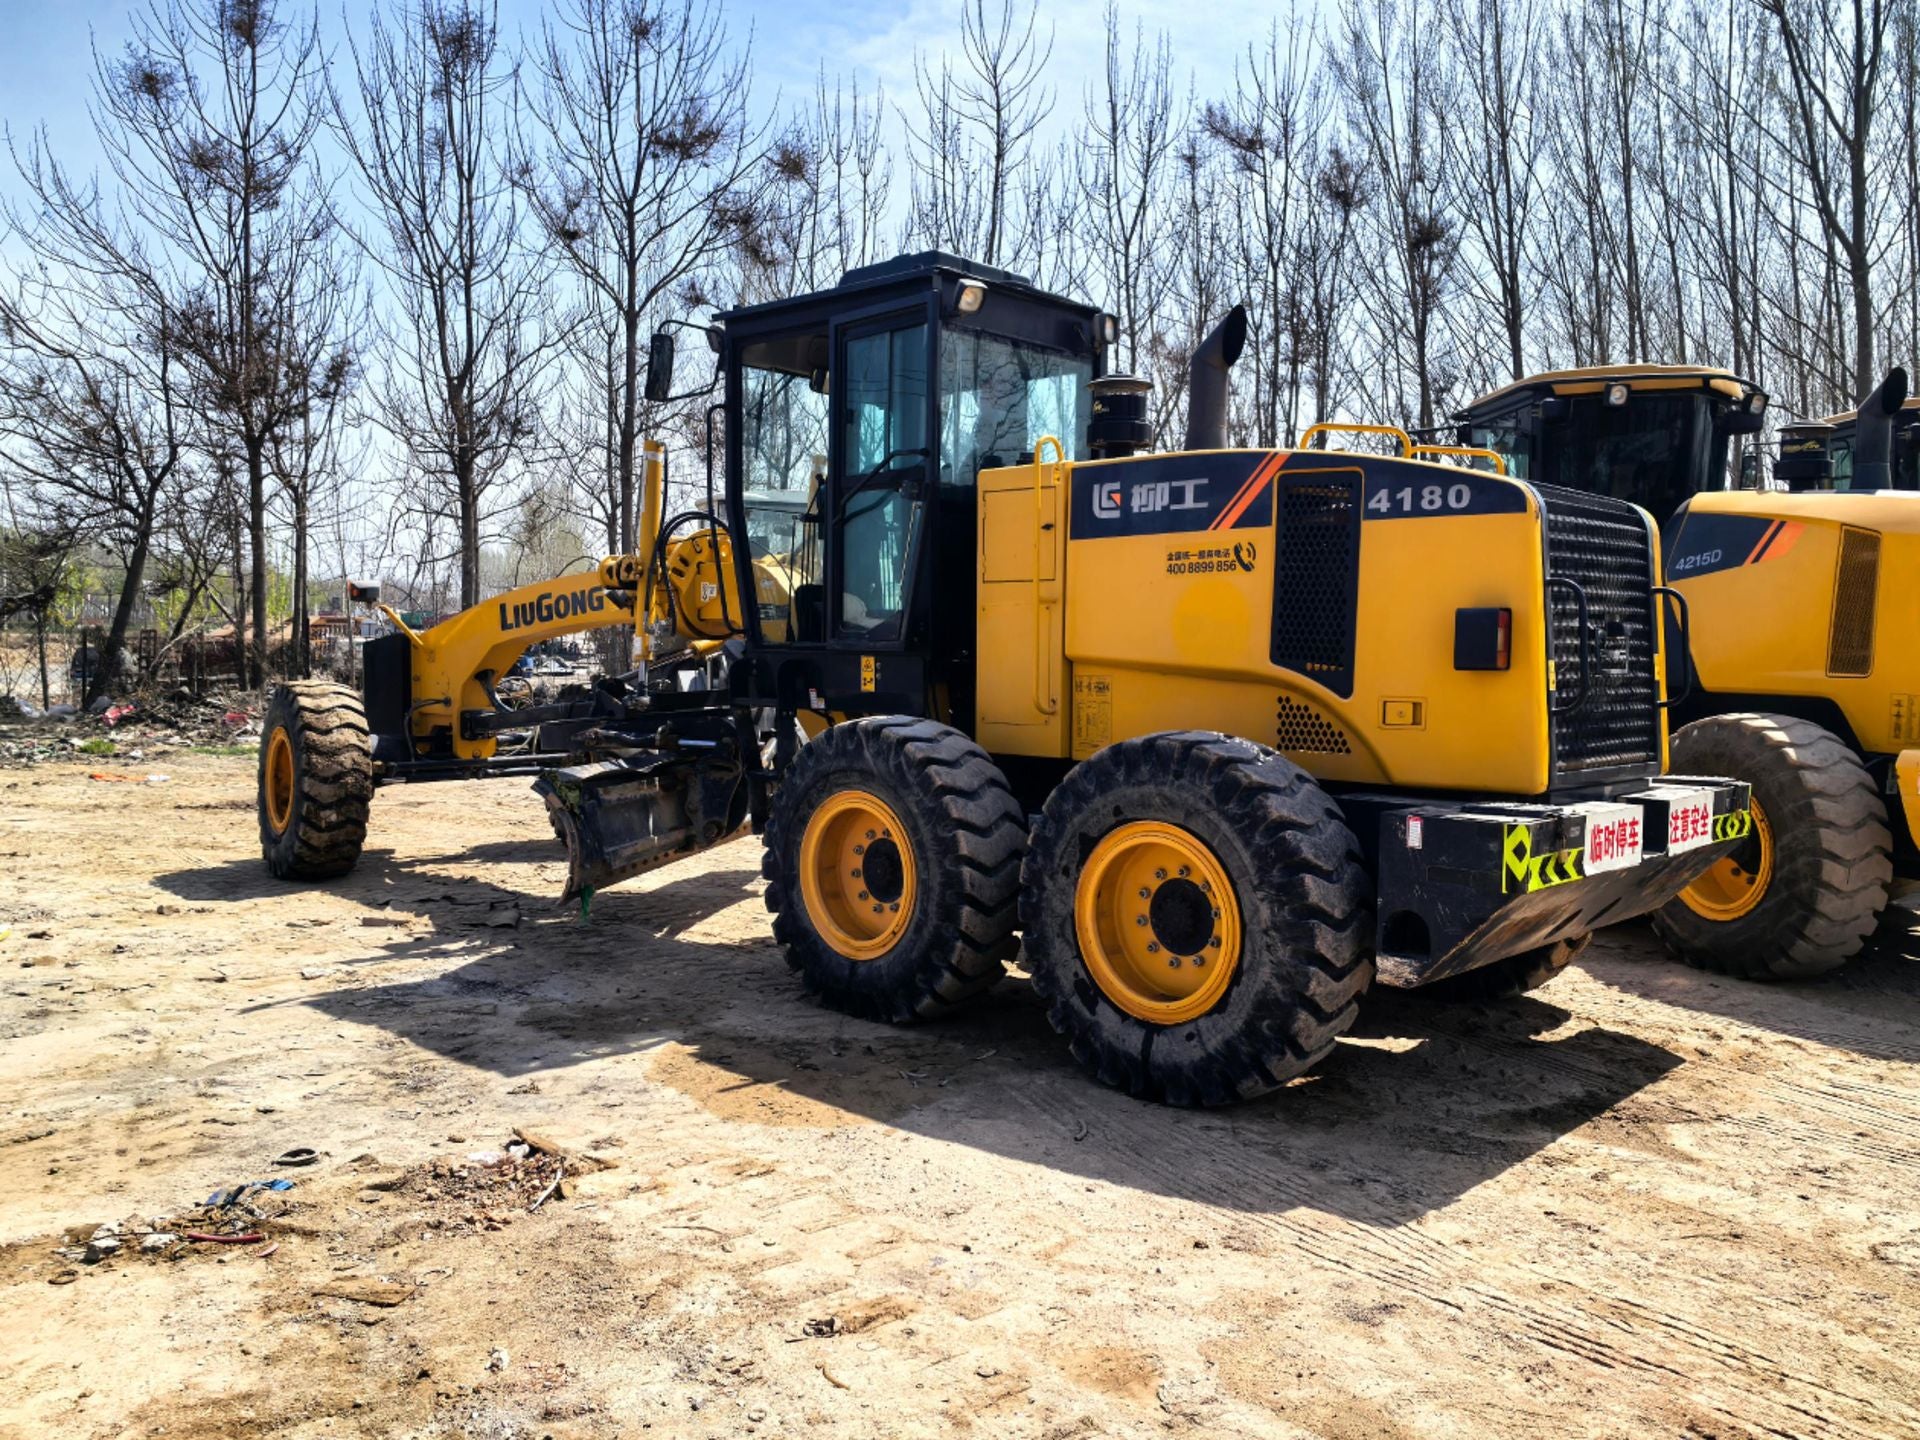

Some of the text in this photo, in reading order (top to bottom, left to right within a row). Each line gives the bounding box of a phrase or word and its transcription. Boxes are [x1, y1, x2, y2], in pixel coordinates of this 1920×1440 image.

[1130, 478, 1209, 513] 柳工
[1367, 483, 1472, 513] 4180
[1167, 560, 1237, 574] 400 8899 856
[1675, 549, 1722, 570] 4215D
[1669, 803, 1709, 844] 注意安全
[1590, 816, 1640, 864] 临时停车
